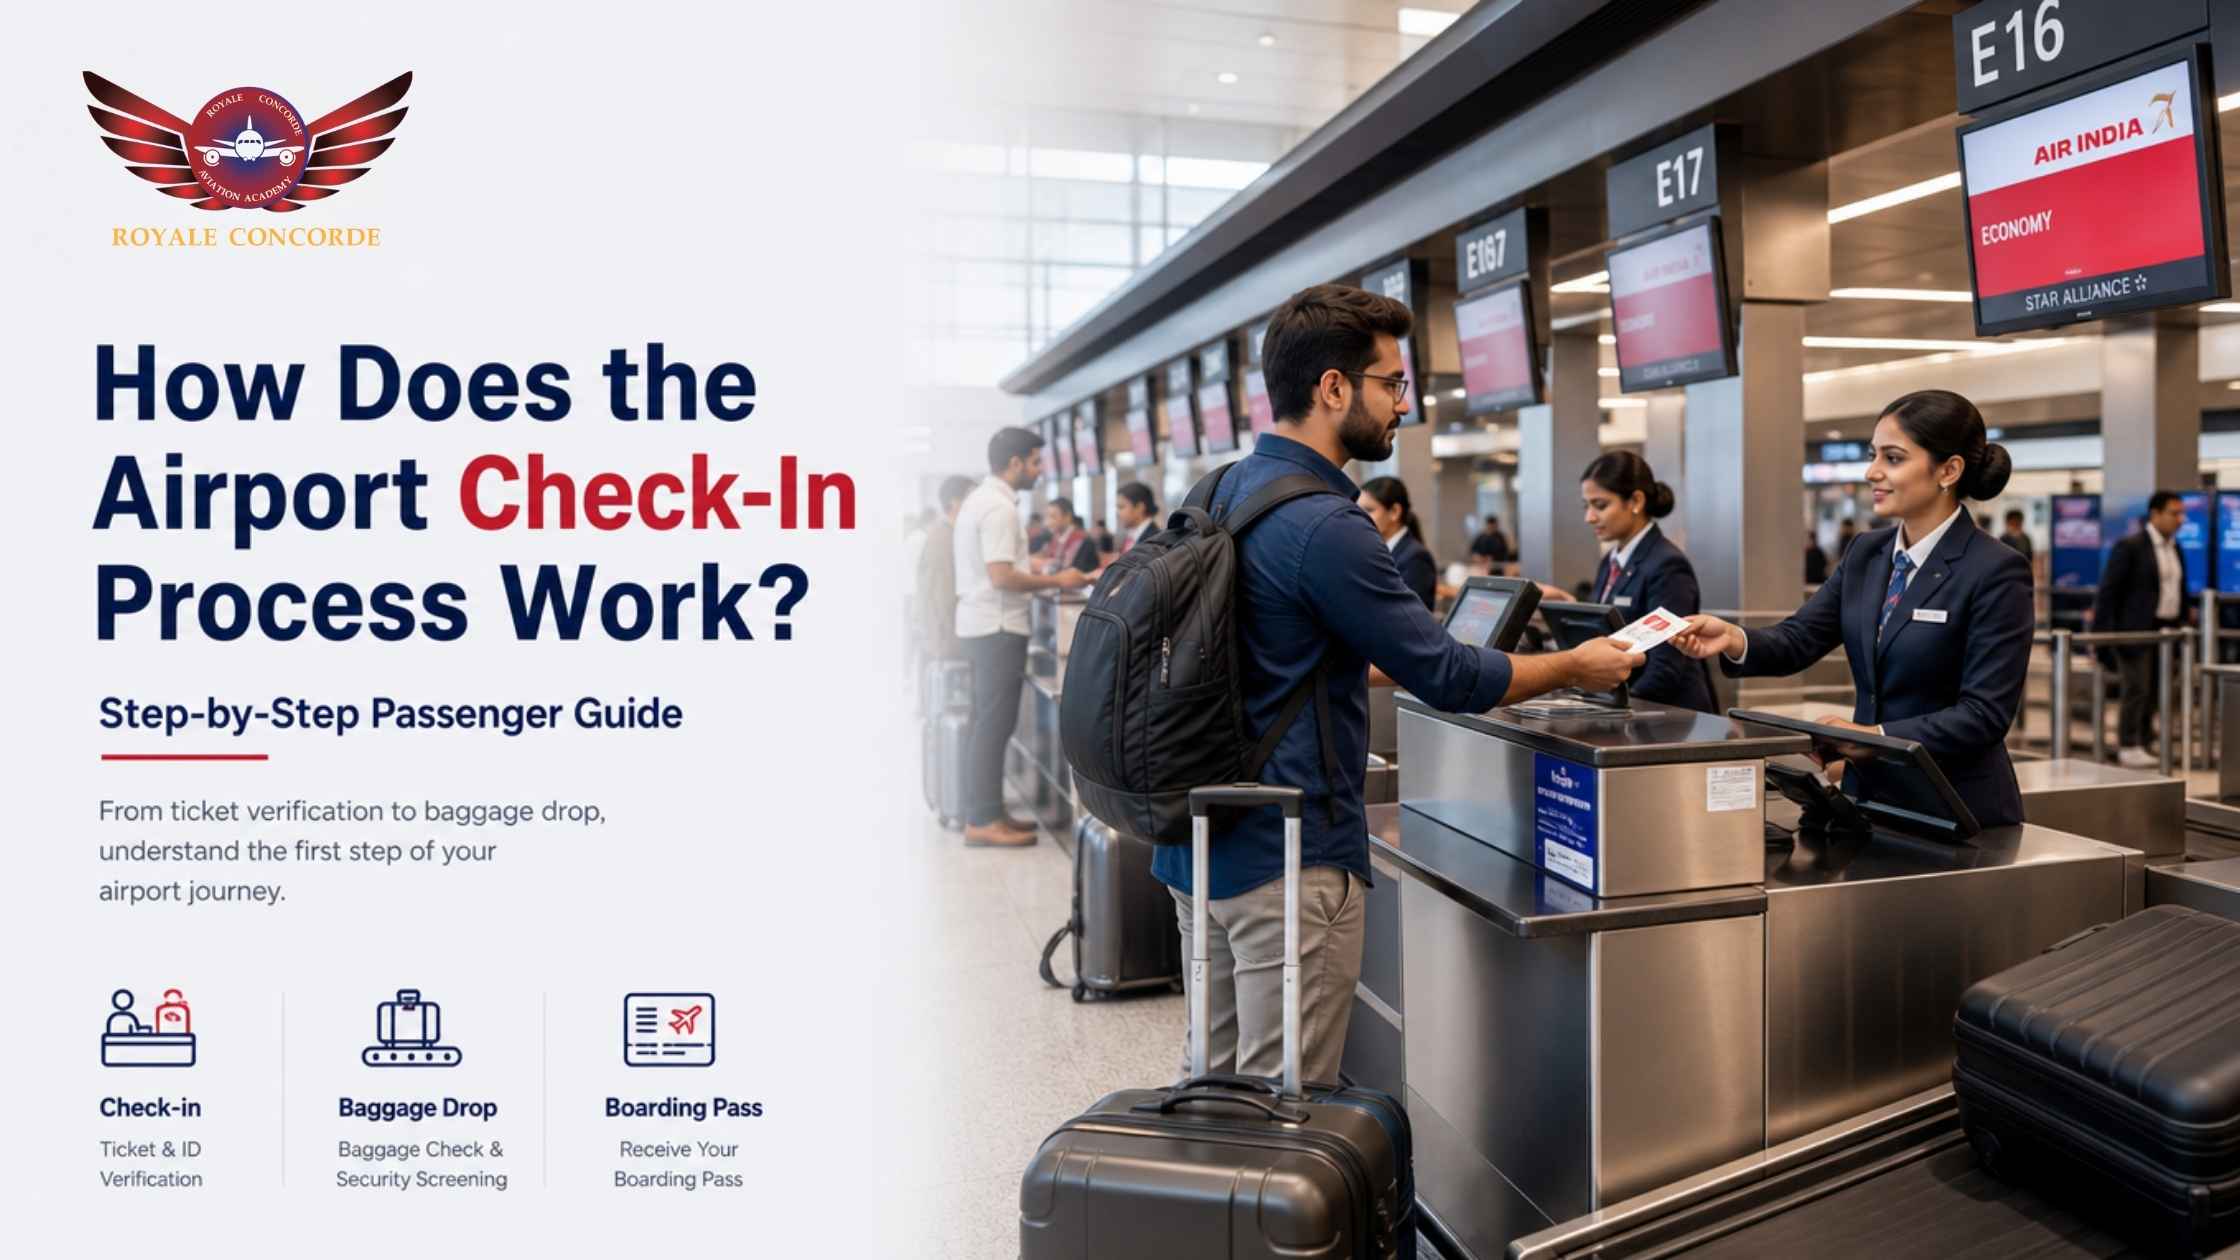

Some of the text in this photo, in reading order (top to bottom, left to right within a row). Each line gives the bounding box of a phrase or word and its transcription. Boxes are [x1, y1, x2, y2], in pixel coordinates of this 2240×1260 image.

[1972, 0, 2065, 88] E16
[2034, 117, 2144, 166] AIR INDIA
[1656, 146, 1704, 208] E17
[1982, 209, 2053, 246] ECONOMY
[2025, 276, 2131, 312] STAR ALLIANCE
